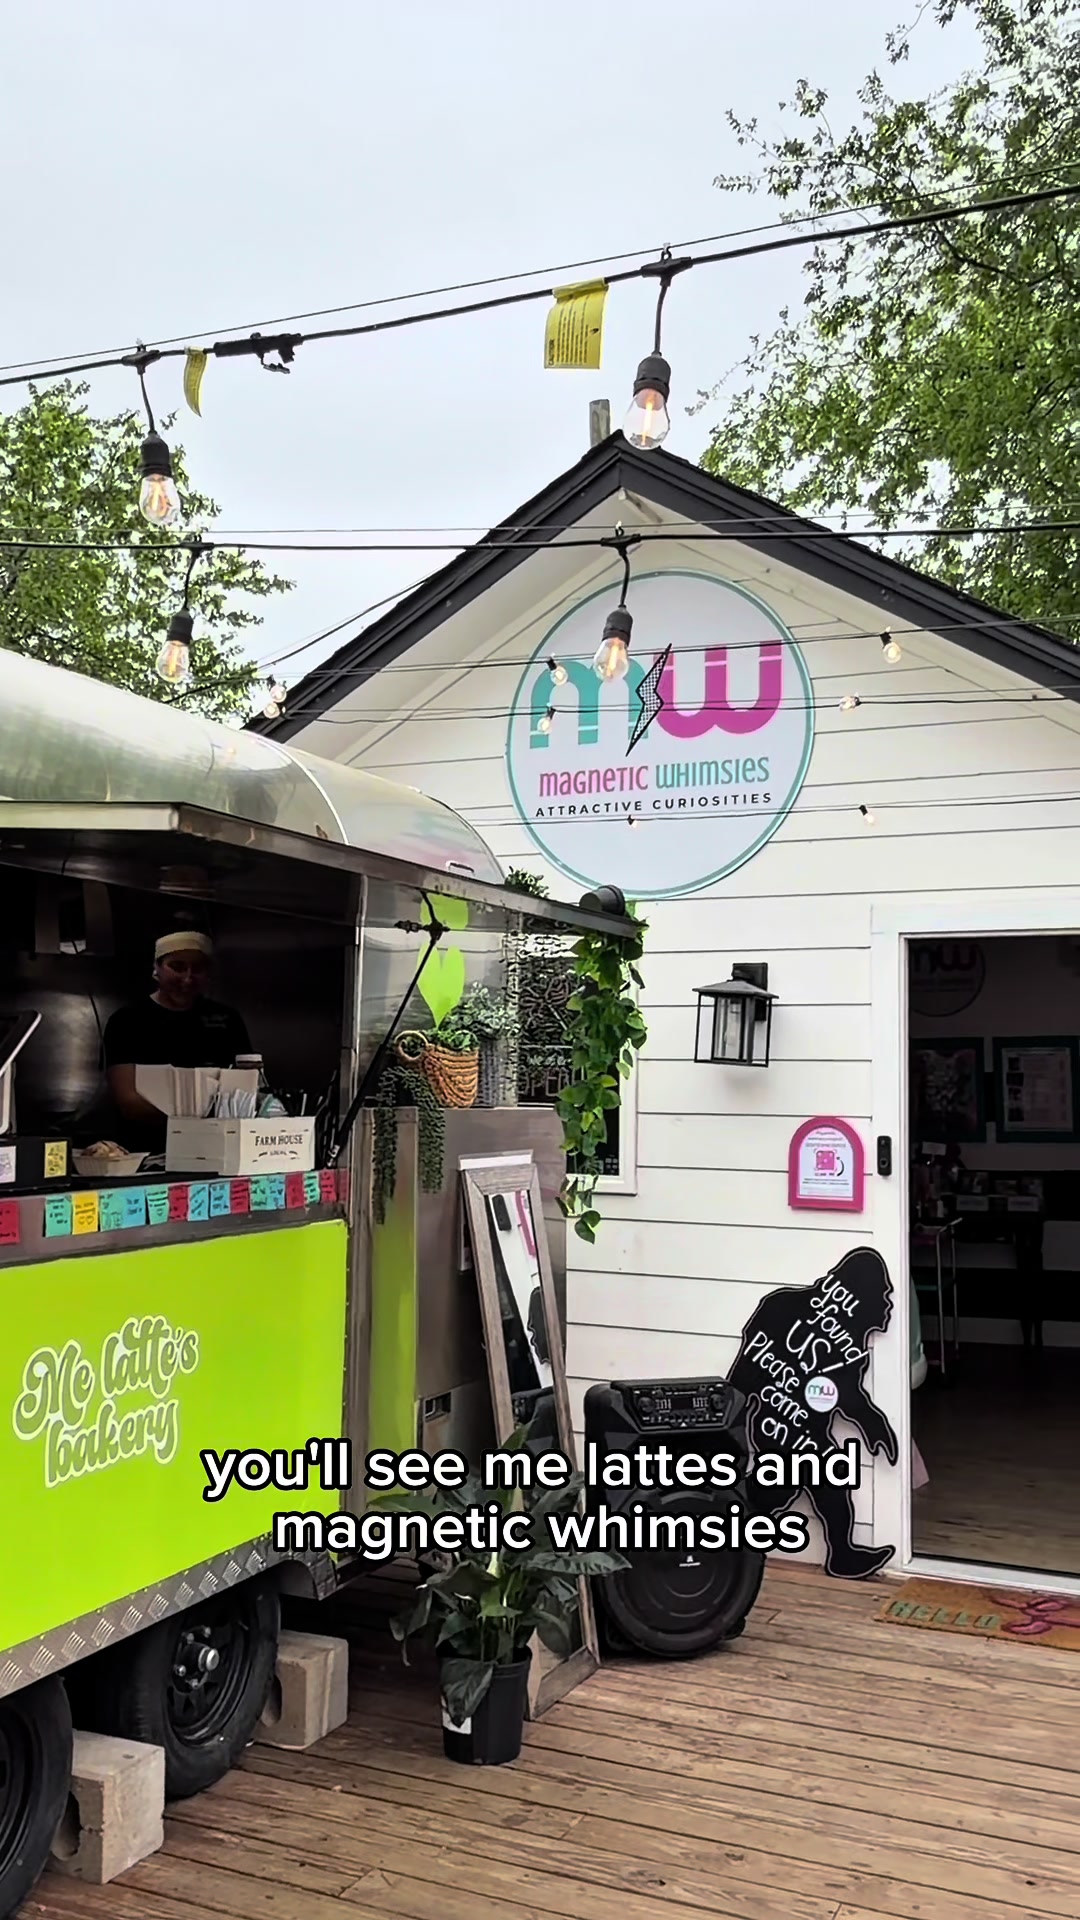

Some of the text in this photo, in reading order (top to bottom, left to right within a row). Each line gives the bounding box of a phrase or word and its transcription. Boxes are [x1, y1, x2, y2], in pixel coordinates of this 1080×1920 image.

[535, 792, 772, 817] ATTRACTIVE CURIOSITIES
[255, 1134, 303, 1146] FARM HOUSE
[810, 1274, 860, 1317] you
[806, 1303, 869, 1365] found
[13, 1316, 199, 1440] Me latte's
[743, 1331, 800, 1393] Please
[760, 1386, 809, 1427] come
[45, 1400, 179, 1488] bakery
[761, 1417, 789, 1446] on
